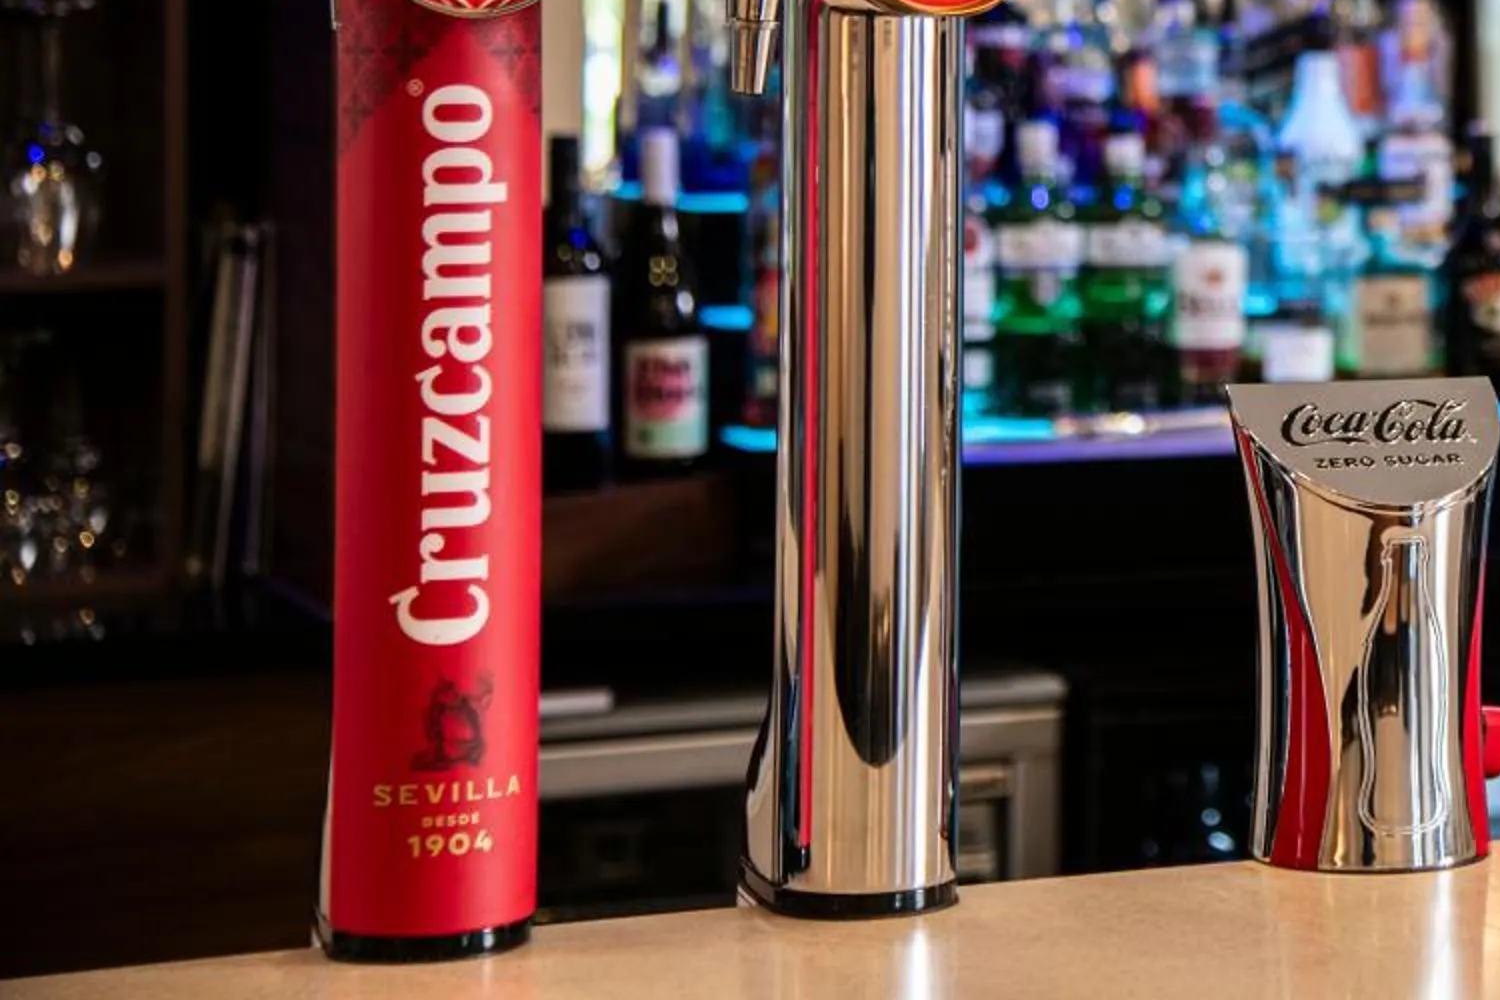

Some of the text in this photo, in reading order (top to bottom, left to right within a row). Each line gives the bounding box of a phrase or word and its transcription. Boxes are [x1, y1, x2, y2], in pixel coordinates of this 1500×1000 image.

[388, 83, 509, 647] Cruzcampo
[1313, 453, 1463, 470] ZERO SUGAR
[373, 774, 521, 808] SEVILLA
[421, 811, 481, 829] DESDE
[407, 828, 494, 860] 1904
